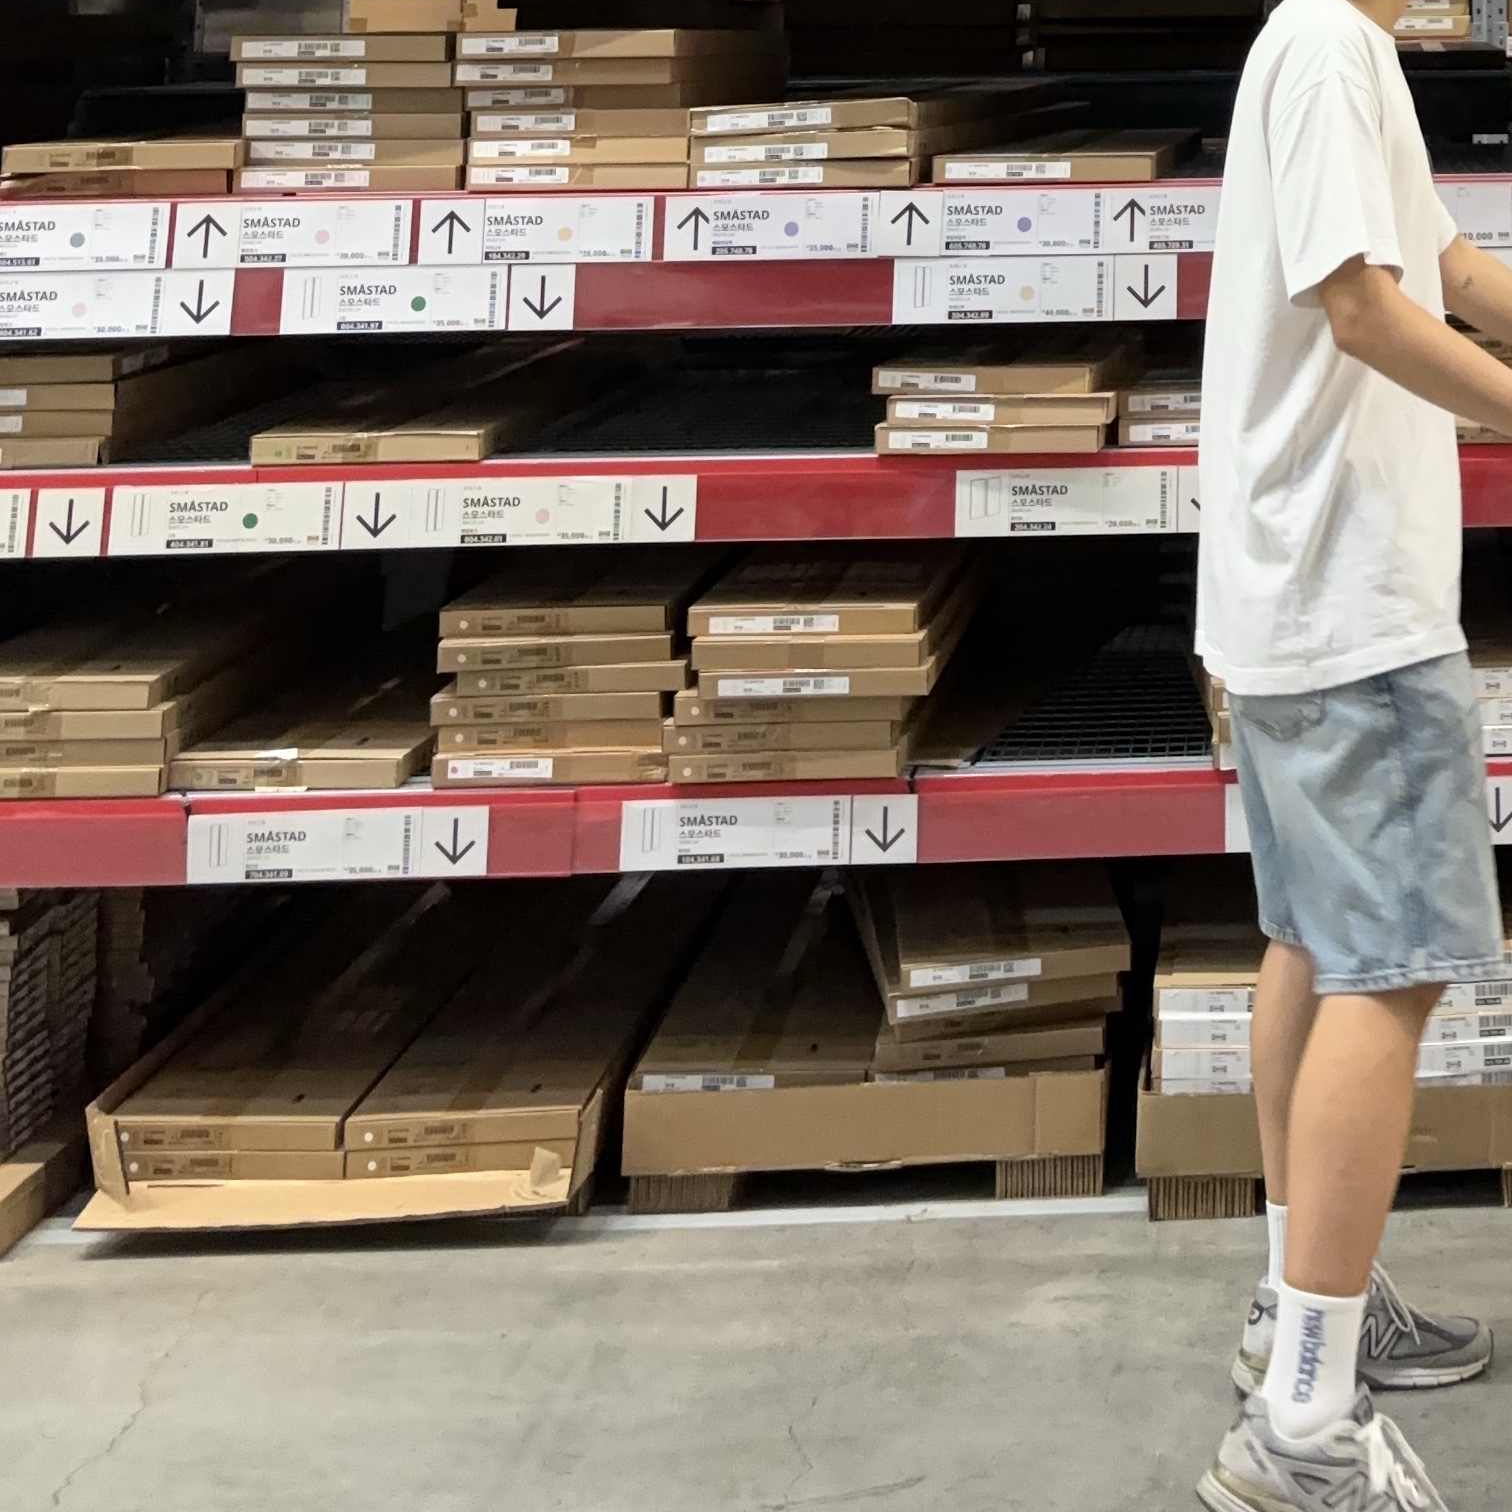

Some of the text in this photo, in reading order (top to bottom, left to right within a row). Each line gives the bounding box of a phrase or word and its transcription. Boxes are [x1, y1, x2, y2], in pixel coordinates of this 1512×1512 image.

[713, 209, 770, 221] SMÅSTAD
[946, 204, 1003, 216] SMÅSTAD
[1149, 204, 1206, 216] SMÅSTAD
[243, 217, 301, 229] SMÅSTAD
[487, 215, 543, 226] SMÅSTAD
[949, 274, 1006, 286] SMÅSTAD
[0, 290, 58, 302] SMÅSTAD
[339, 284, 397, 296] SMÅSTAD
[1011, 484, 1068, 496] SMÅSTAD
[169, 500, 228, 513] SMÅSTAD
[463, 496, 521, 508] SMÅSTAD
[679, 814, 738, 827] SMÅSTAD
[246, 831, 306, 844] SMÅSTAD
